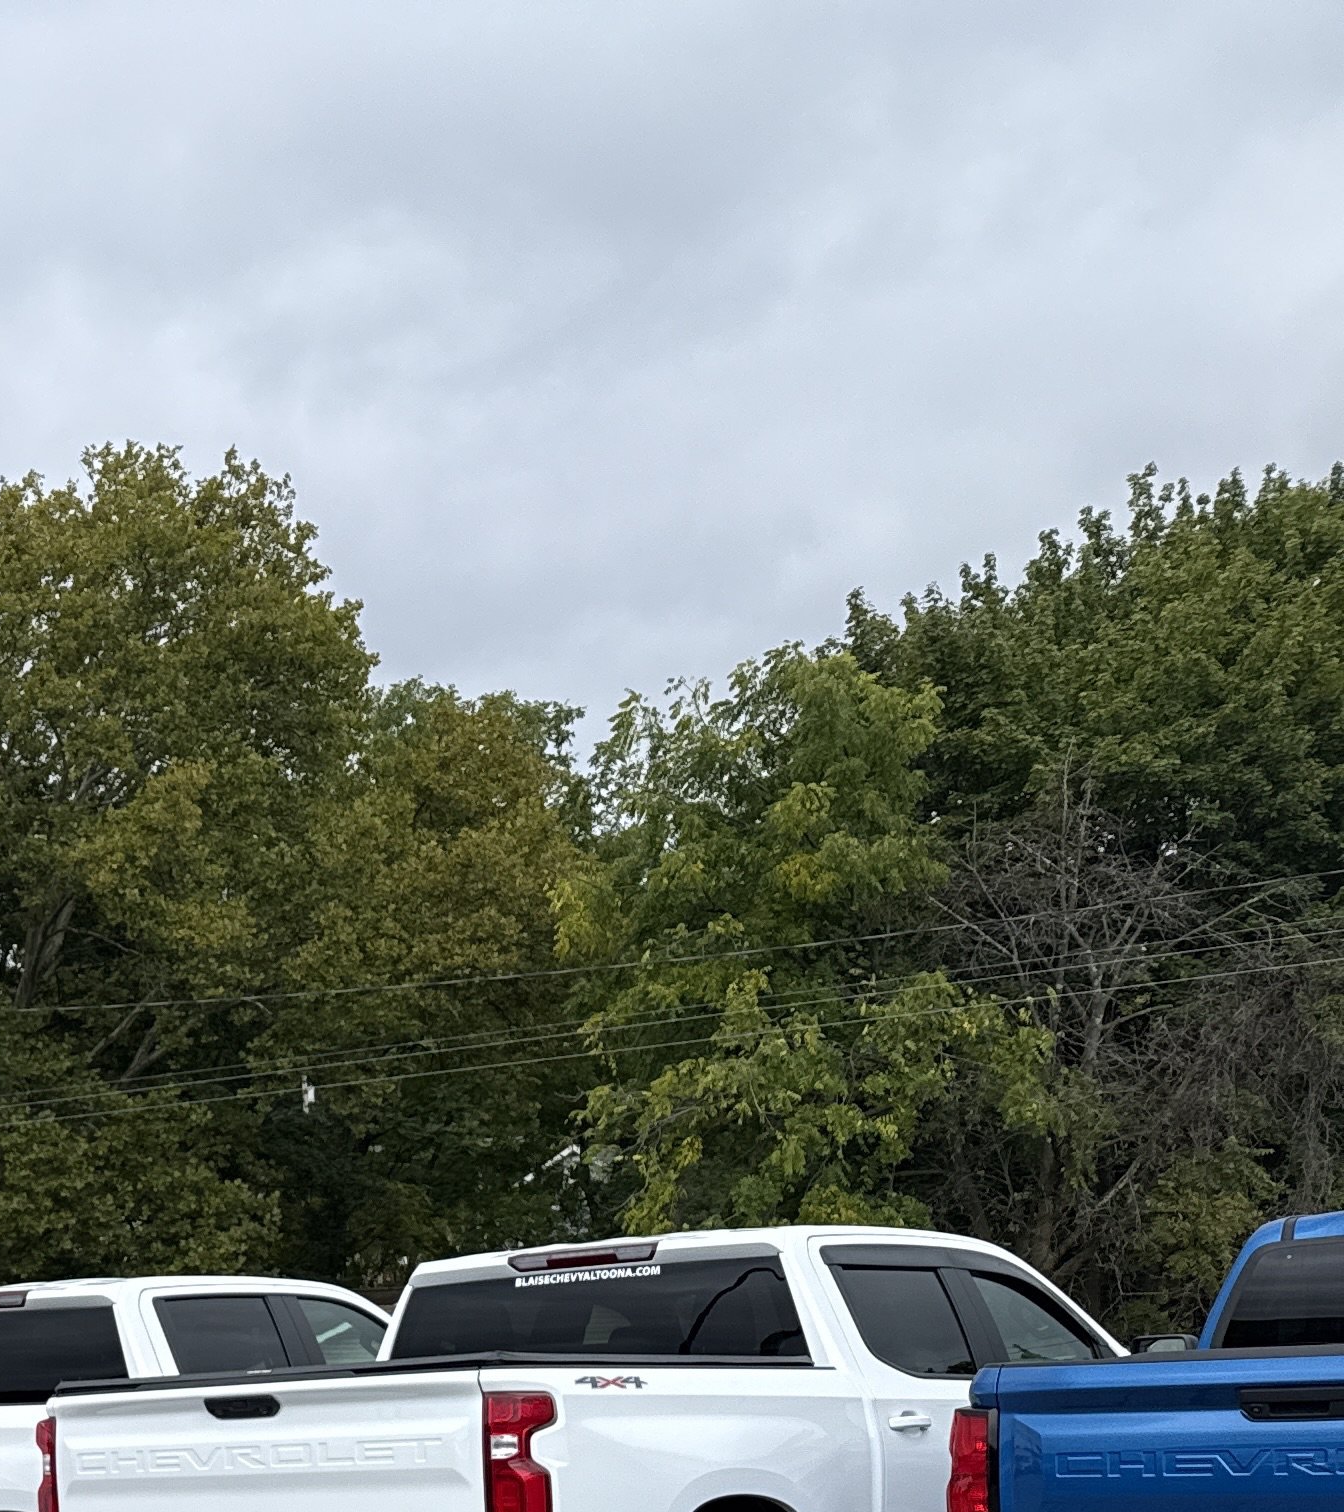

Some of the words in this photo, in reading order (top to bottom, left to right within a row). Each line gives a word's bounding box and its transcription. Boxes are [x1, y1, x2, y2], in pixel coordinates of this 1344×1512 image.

[514, 1265, 661, 1288] BLAISECHEVYALTOONA.COM
[75, 1437, 443, 1476] CHEVROLET
[1054, 1447, 1344, 1478] CHEVR
